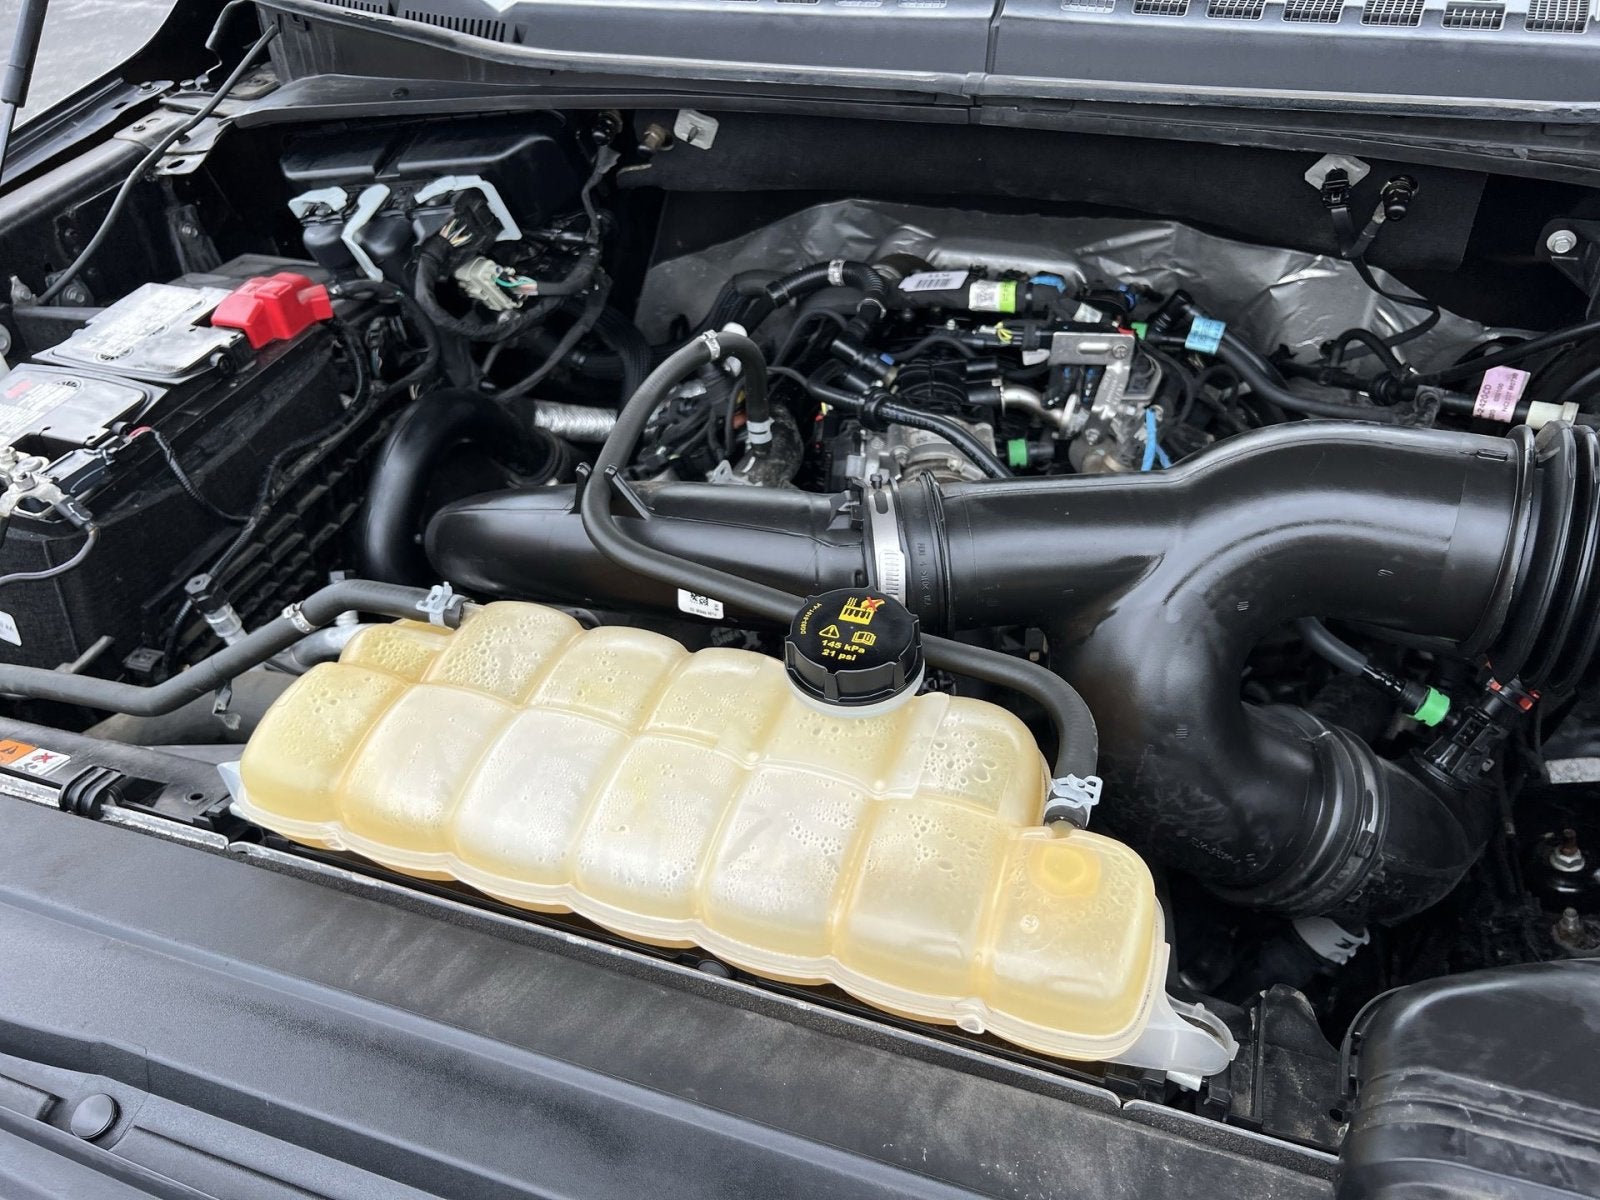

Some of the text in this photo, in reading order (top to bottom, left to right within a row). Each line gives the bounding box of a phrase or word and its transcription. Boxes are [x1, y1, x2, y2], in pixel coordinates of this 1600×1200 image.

[822, 640, 866, 654] 145 kPa
[822, 649, 836, 657] 21
